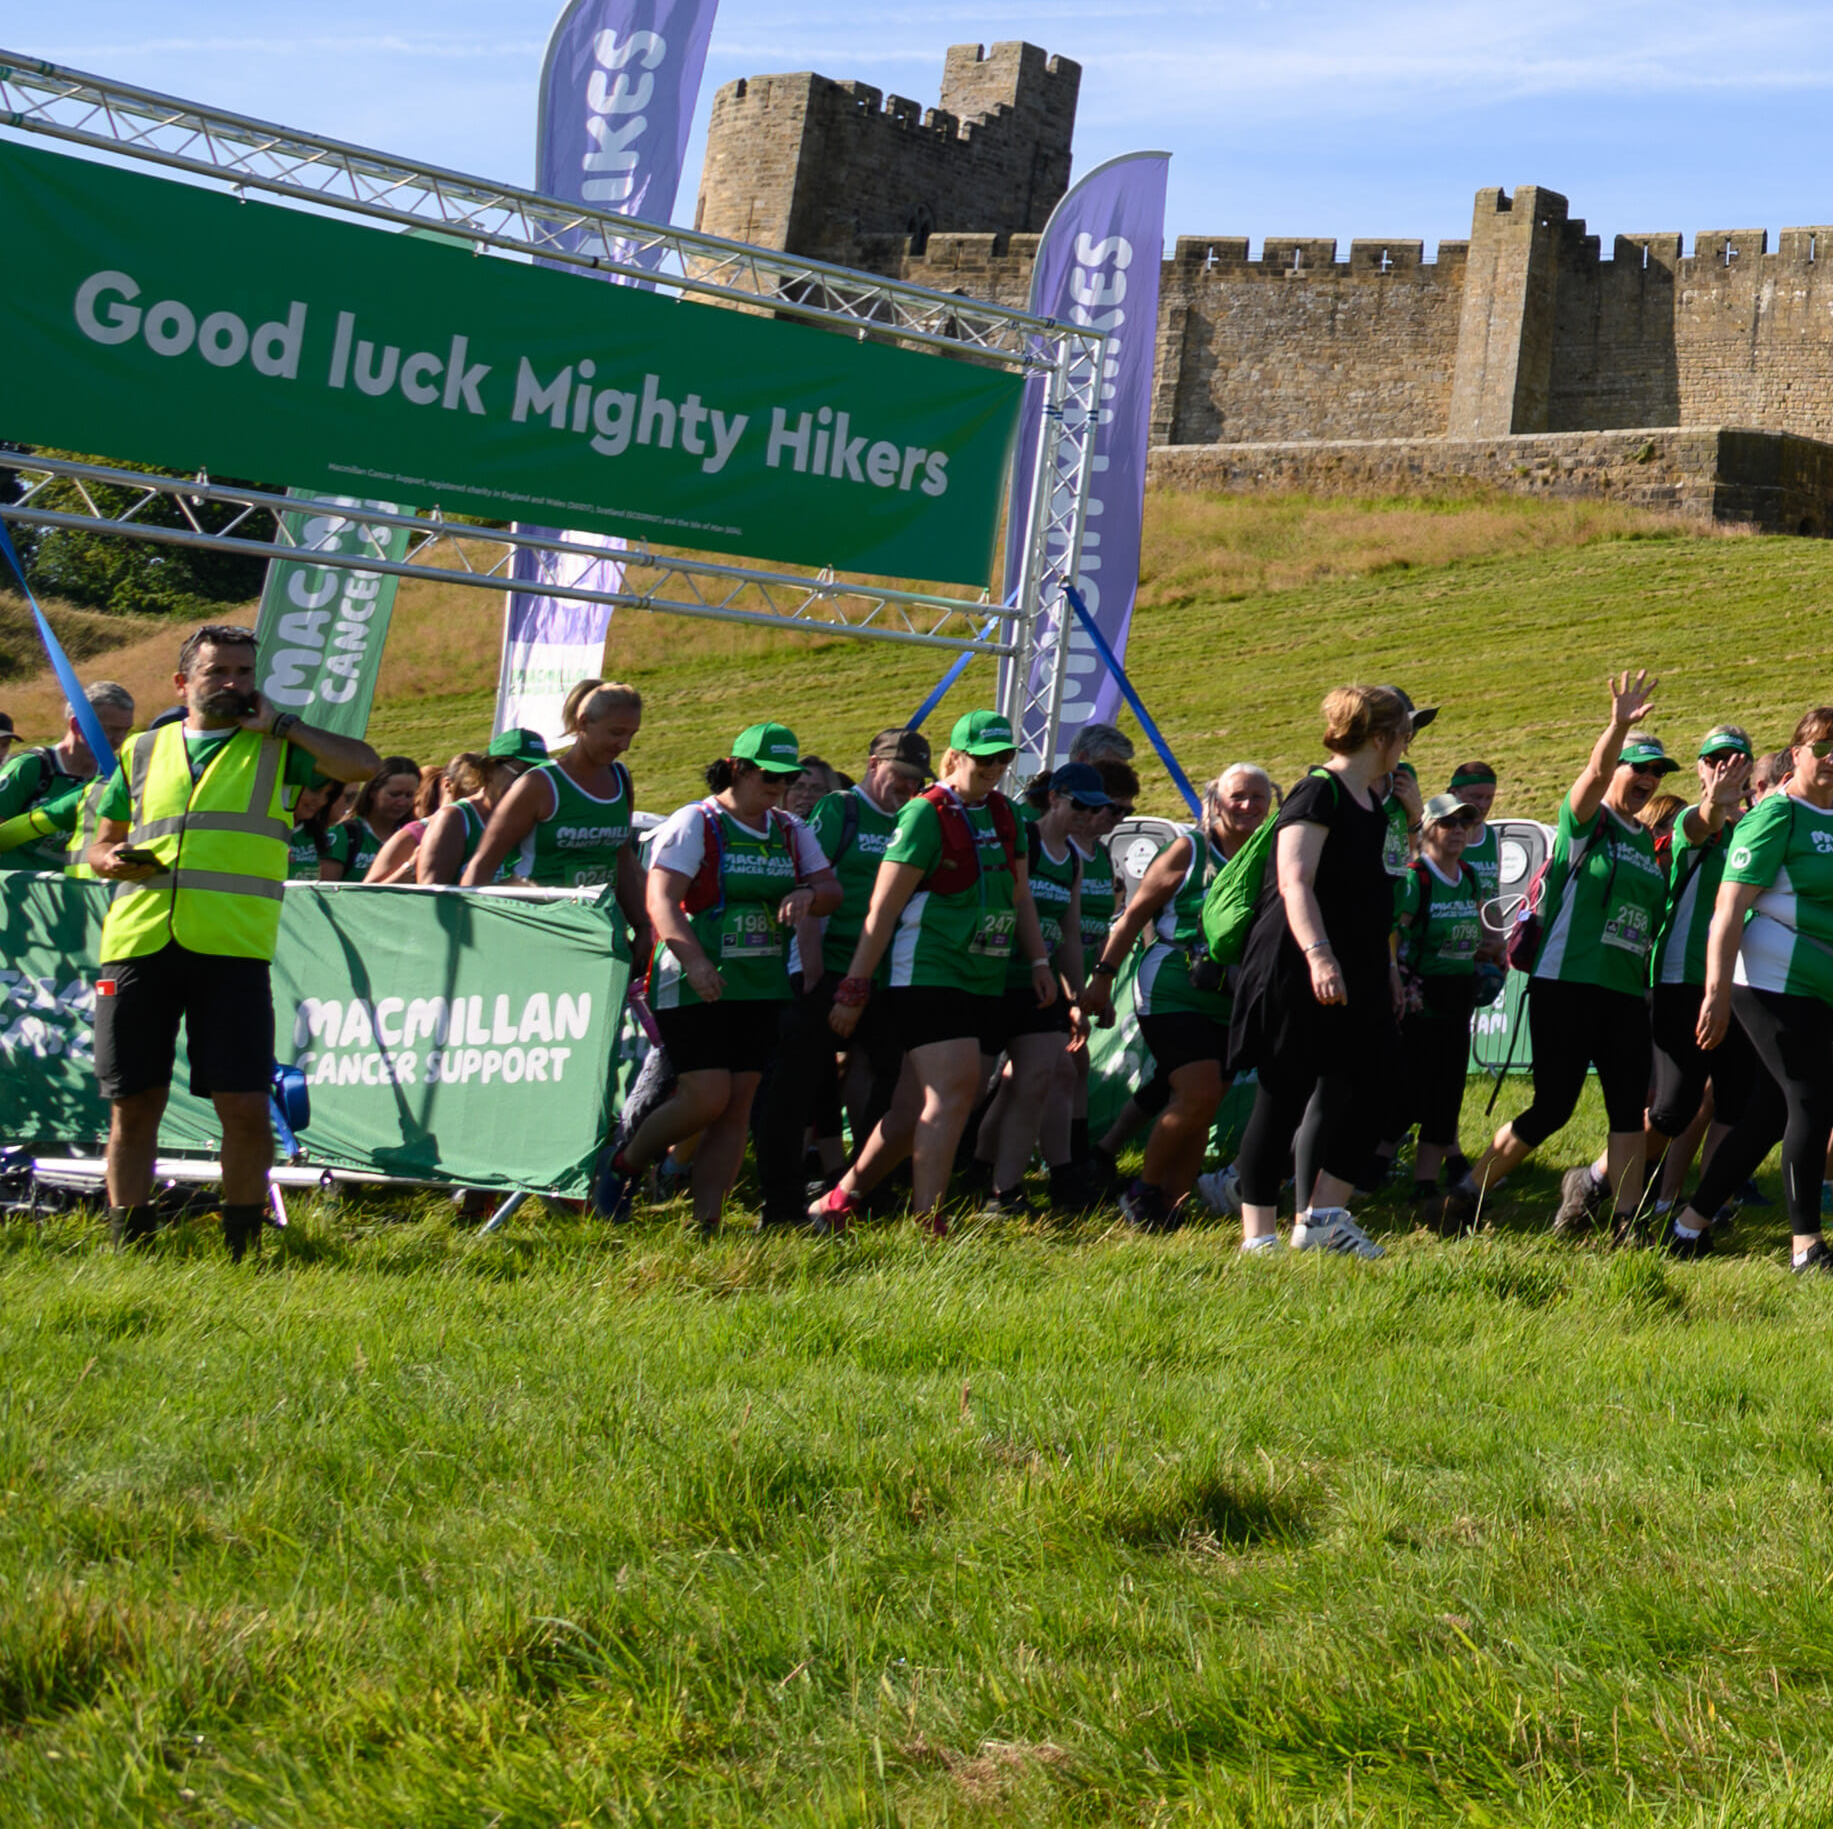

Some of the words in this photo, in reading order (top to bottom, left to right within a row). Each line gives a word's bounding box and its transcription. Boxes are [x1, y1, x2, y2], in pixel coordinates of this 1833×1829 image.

[74, 270, 308, 380] Good
[328, 311, 492, 415] luck
[511, 356, 750, 474] Mighty
[766, 406, 951, 497] Hikers
[264, 496, 361, 706] MACM
[293, 992, 592, 1049] MACMILLAN
[295, 1050, 418, 1086] CANCER
[424, 1046, 571, 1084] SUPPORT
